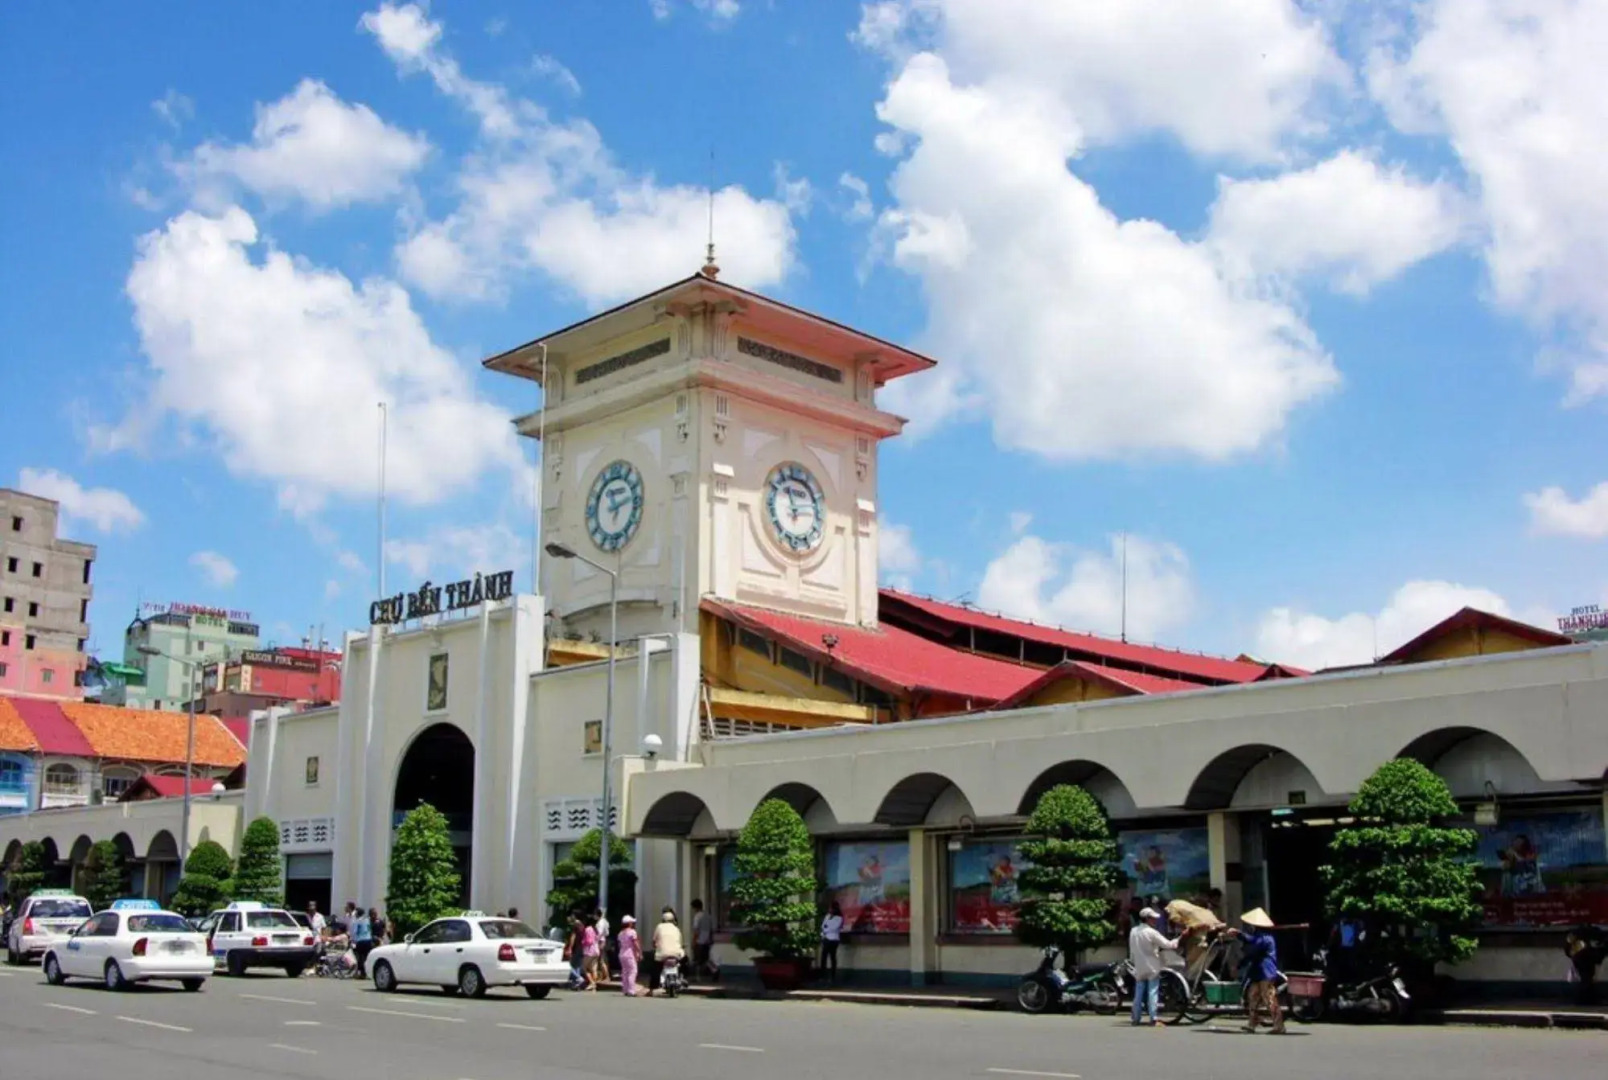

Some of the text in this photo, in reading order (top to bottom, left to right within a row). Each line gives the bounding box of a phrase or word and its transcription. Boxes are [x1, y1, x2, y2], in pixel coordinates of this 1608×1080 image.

[407, 580, 442, 618] BẾN
[445, 570, 514, 610] THÀNH
[1571, 604, 1600, 615] HOTEL
[195, 615, 224, 628] HOTEL
[245, 651, 272, 662] SAIGON
[275, 655, 293, 666] PINK
